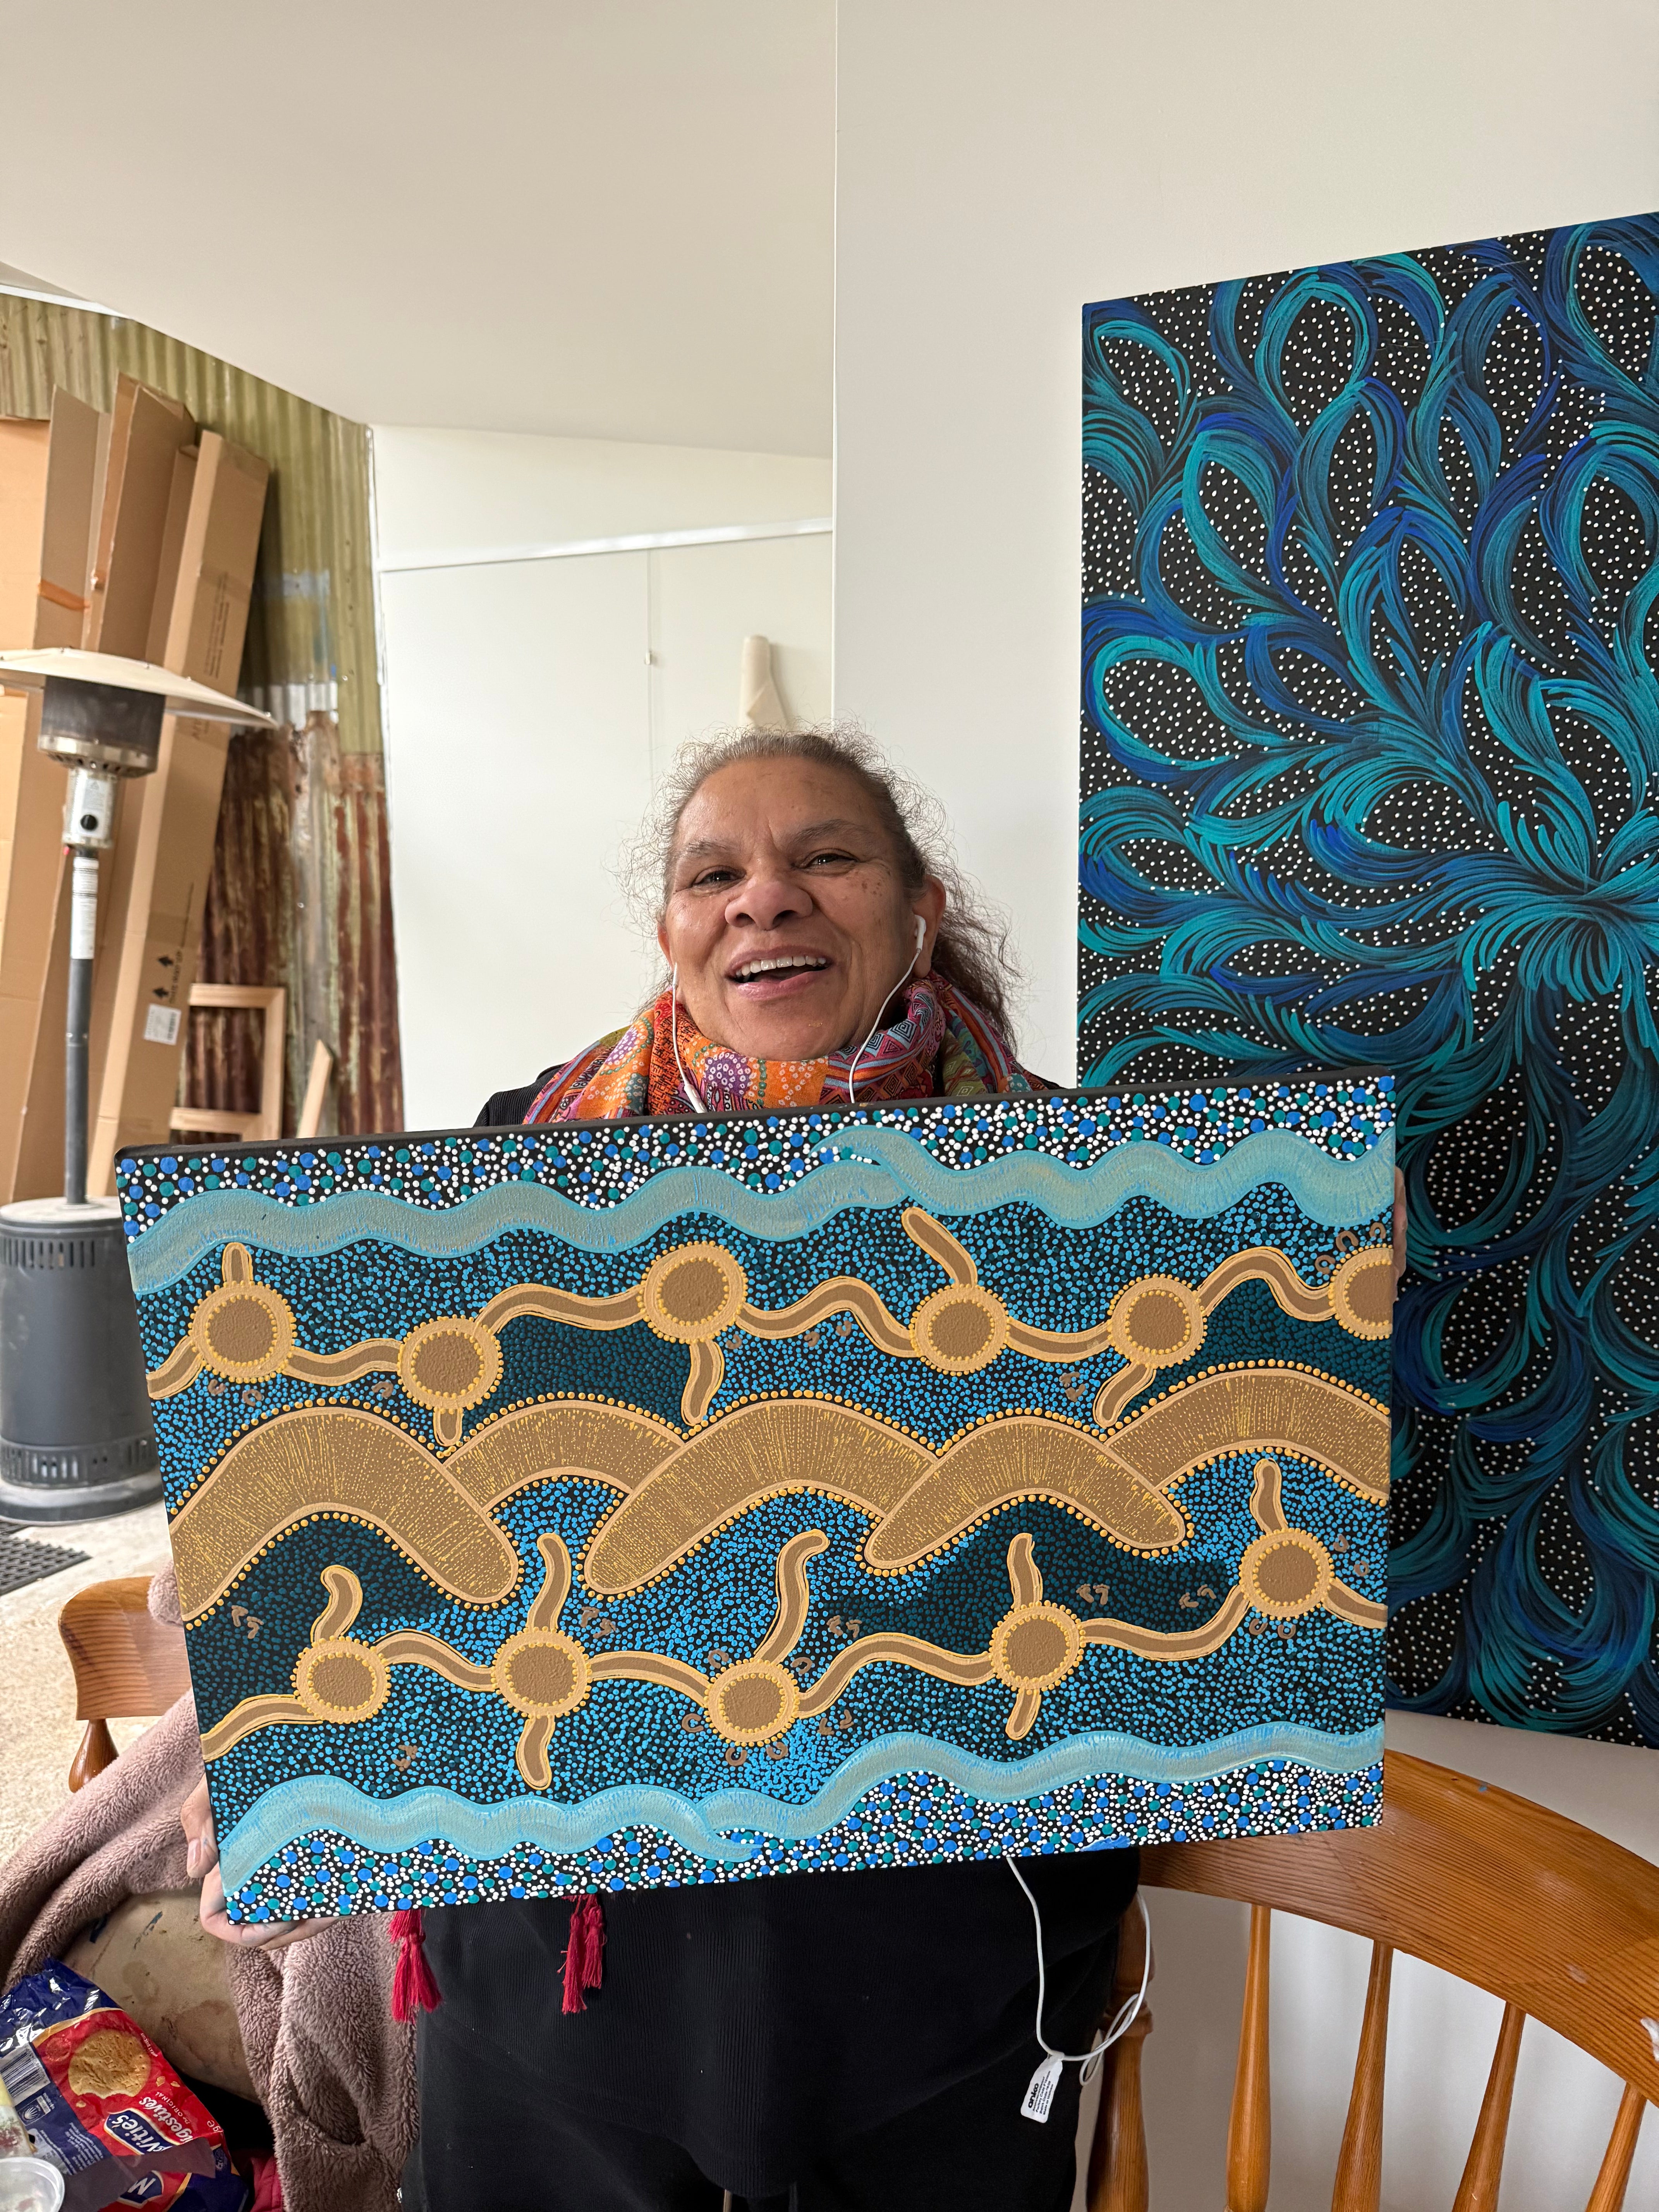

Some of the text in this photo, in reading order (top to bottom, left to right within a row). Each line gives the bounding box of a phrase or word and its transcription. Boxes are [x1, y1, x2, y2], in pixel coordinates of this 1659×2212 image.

[155, 2092, 183, 2117] ORIGINAL
[1028, 2083, 1039, 2108] anko
[112, 2115, 173, 2152] cVitie's
[139, 2097, 194, 2142] igestives
